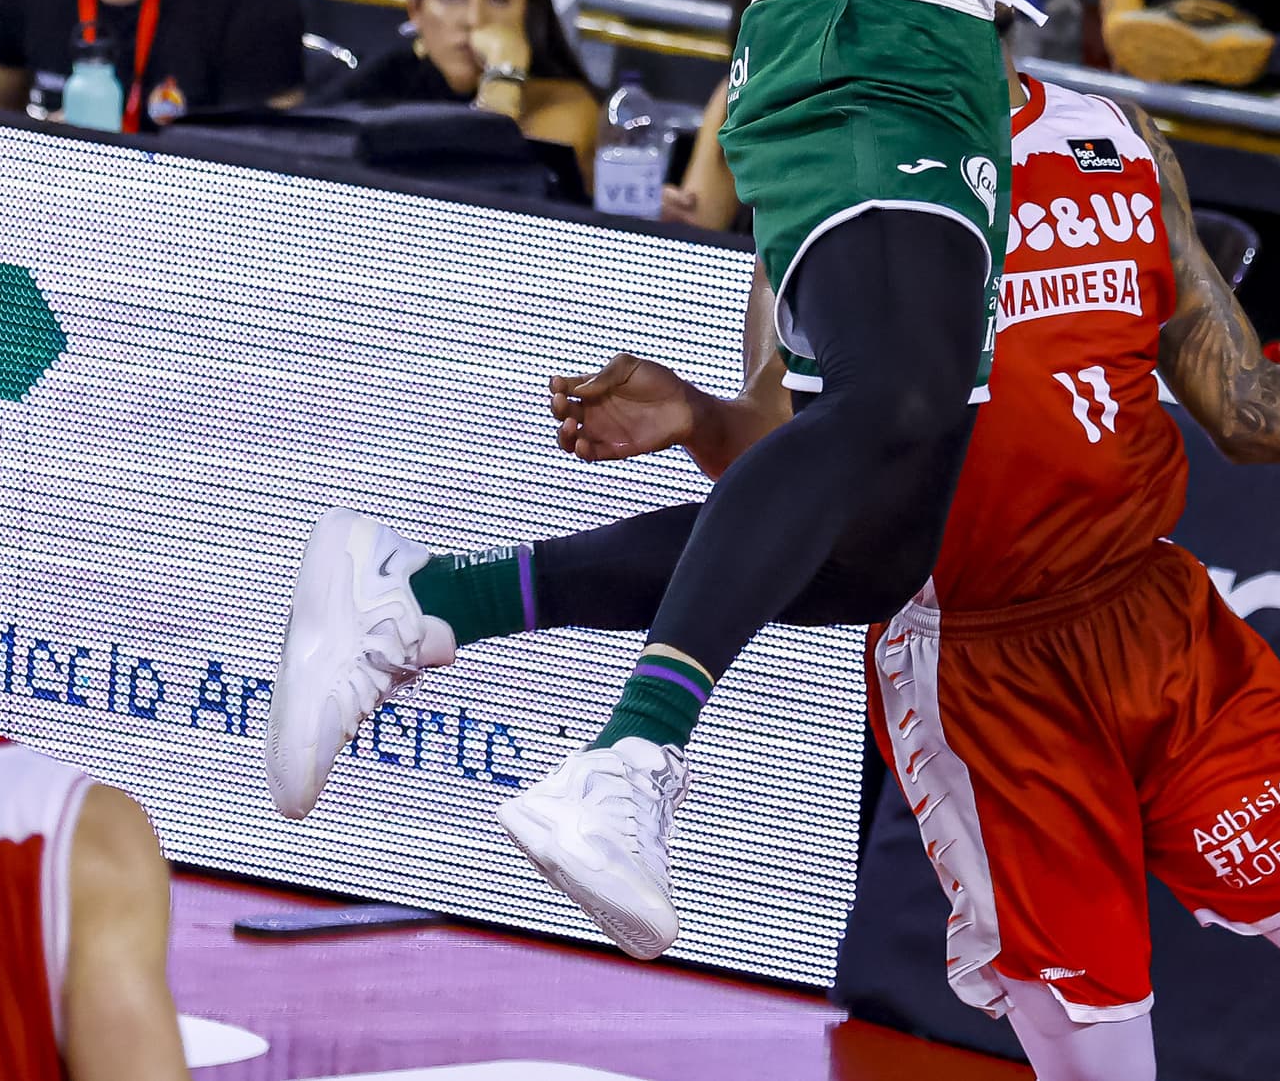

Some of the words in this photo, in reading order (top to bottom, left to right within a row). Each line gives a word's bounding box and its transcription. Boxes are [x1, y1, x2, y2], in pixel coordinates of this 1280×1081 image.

[1080, 157, 1120, 167] endesa
[998, 267, 1136, 318] MANRESA
[1053, 365, 1118, 443] 11
[1204, 831, 1269, 877] ETL
